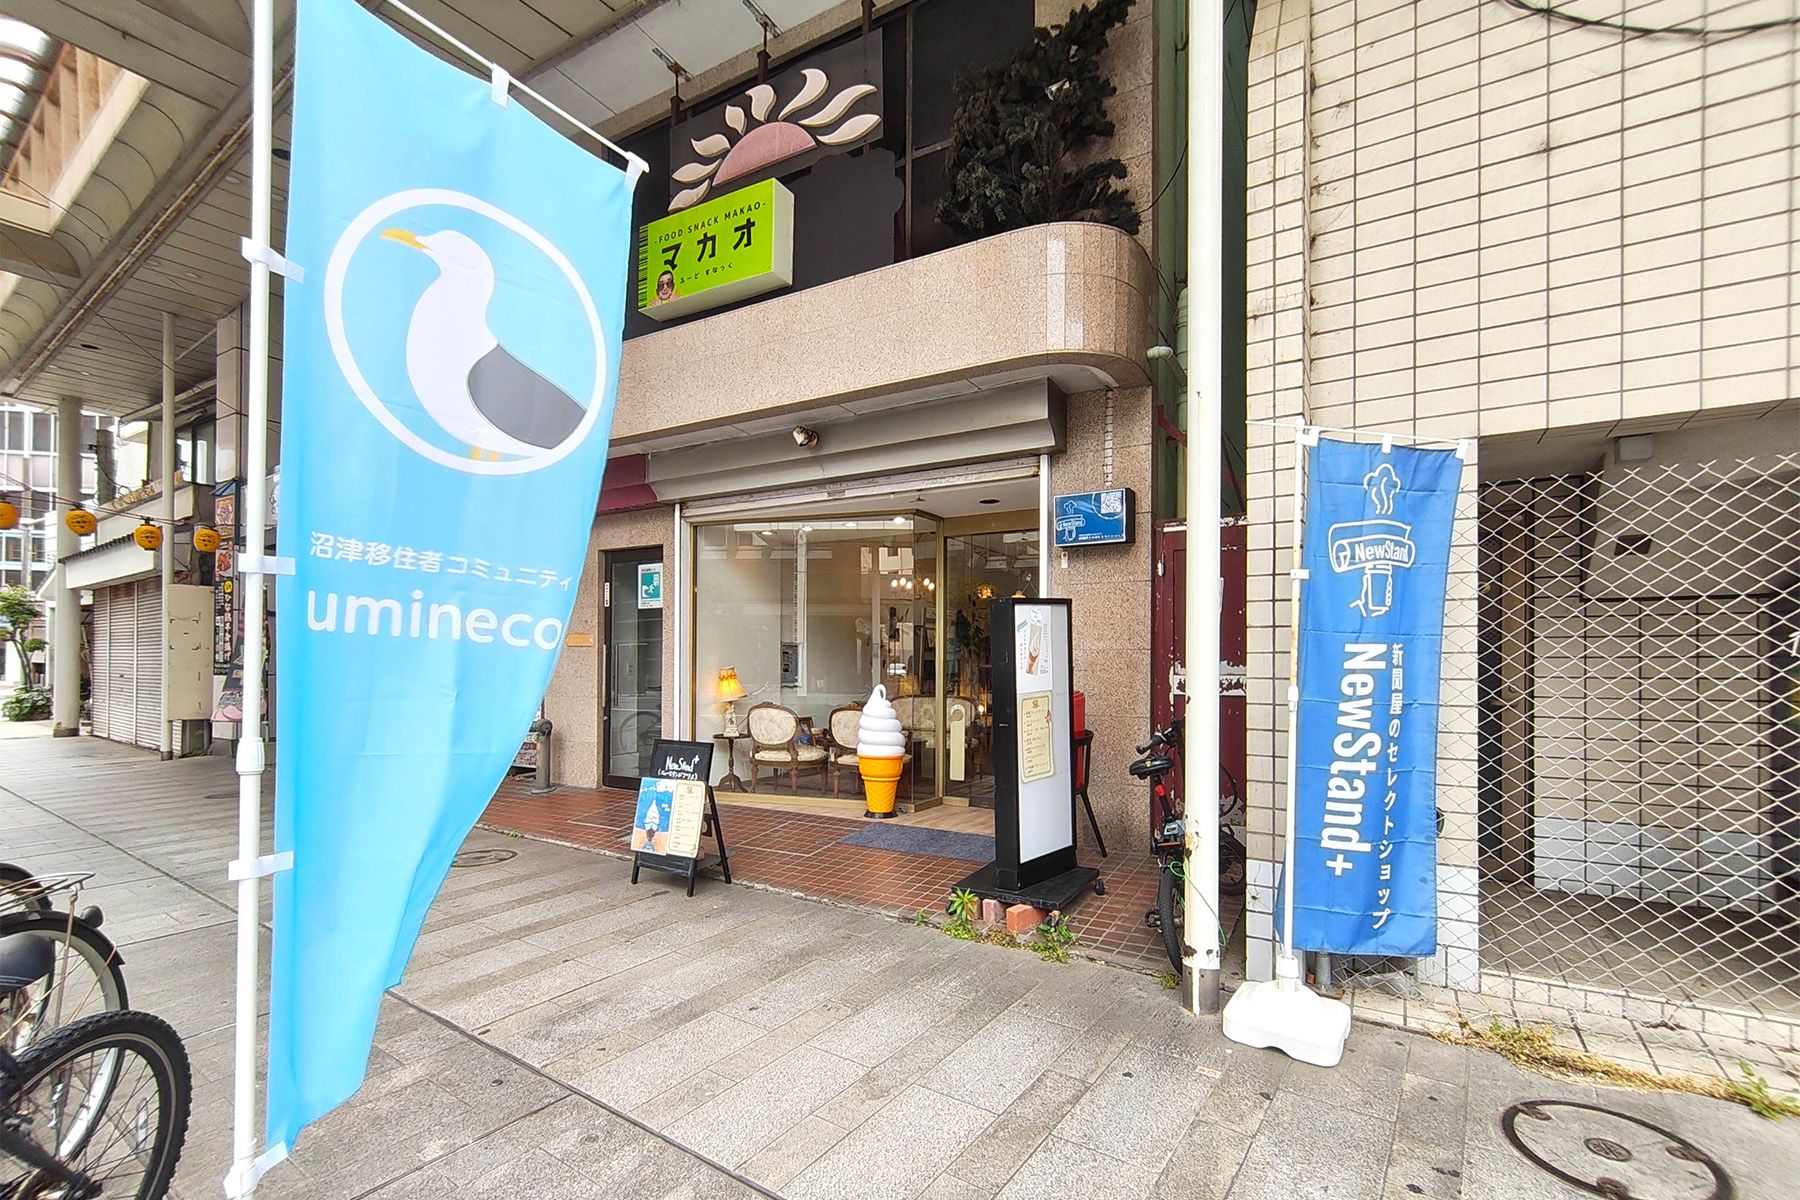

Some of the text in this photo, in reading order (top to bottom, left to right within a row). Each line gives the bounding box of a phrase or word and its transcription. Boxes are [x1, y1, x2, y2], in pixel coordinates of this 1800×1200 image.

[661, 217, 756, 271] マカオ
[687, 215, 719, 234] SNACK
[310, 531, 573, 592] 沼津移住者コミュニティ
[307, 588, 563, 651] umineco
[1371, 642, 1404, 930] 新聞屋のセレクトショップ
